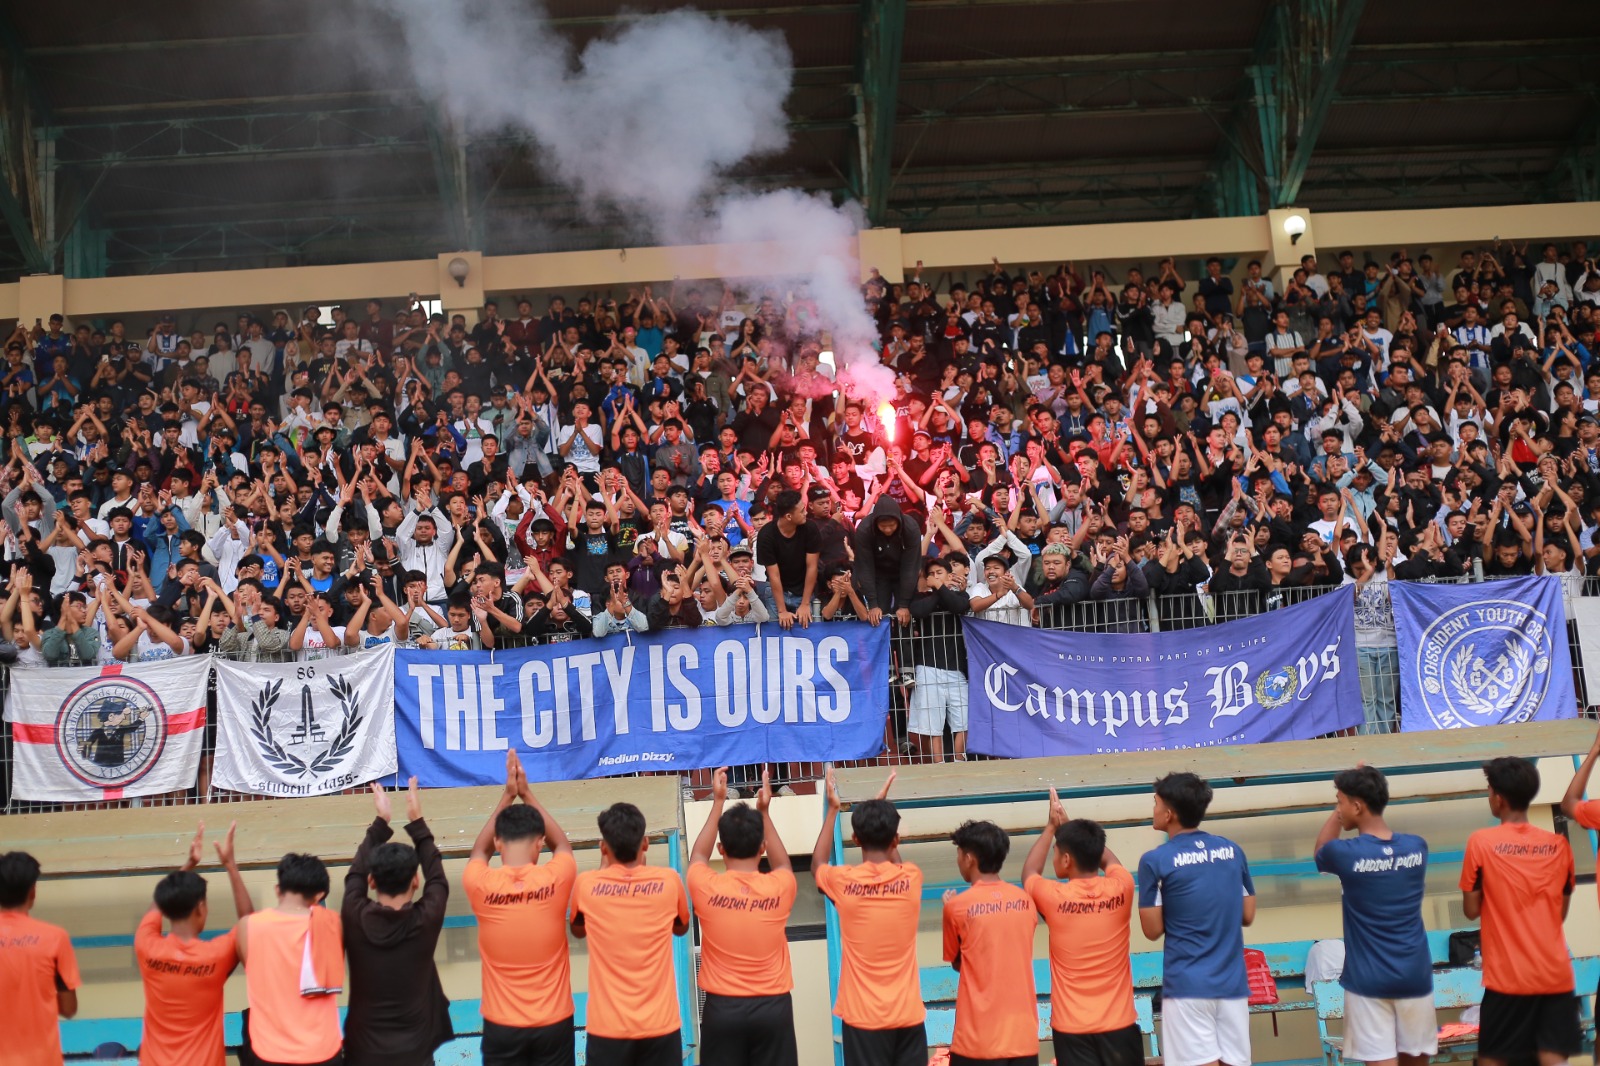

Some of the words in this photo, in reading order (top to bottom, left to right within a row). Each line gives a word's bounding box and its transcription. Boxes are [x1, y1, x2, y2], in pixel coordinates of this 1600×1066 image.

[1058, 653, 1104, 663] MADIUN
[1160, 652, 1188, 662] PART
[1197, 648, 1210, 657] OF
[1218, 644, 1233, 653] MY
[1241, 636, 1267, 648] LIFE
[1424, 613, 1470, 676] DISSIDENT
[1476, 608, 1528, 627] YOUTH
[297, 666, 315, 680] 86
[408, 663, 509, 752] THE
[518, 645, 636, 749] CITY
[648, 642, 701, 733] IS
[713, 636, 853, 729] OURS
[984, 661, 1189, 737] Campus
[1204, 635, 1342, 728] Bys
[66, 704, 85, 744] Madiun
[85, 688, 111, 704] Lads
[1195, 733, 1245, 748] MINUTES
[598, 753, 639, 767] Madiun
[1174, 849, 1208, 867] MADIUN
[1210, 847, 1234, 865] PUTRA
[1495, 843, 1529, 857] MADIUN
[1532, 844, 1558, 857] PUTRA
[1354, 857, 1393, 873] MADIUN
[1394, 852, 1422, 871] PUTRA
[484, 891, 523, 906] MADIUN
[526, 883, 555, 904] PUTRA
[591, 882, 631, 897] MADIUN
[632, 882, 664, 897] PUTRA
[844, 883, 881, 897] MADIUN
[882, 879, 910, 896] PUTRA
[708, 895, 748, 911] MADIUN
[749, 896, 780, 912] PUTRA
[967, 903, 1001, 919] MADIUN
[1005, 900, 1030, 912] PUTRA
[1057, 900, 1095, 914] MADIUN
[1098, 896, 1125, 914] PUTRA
